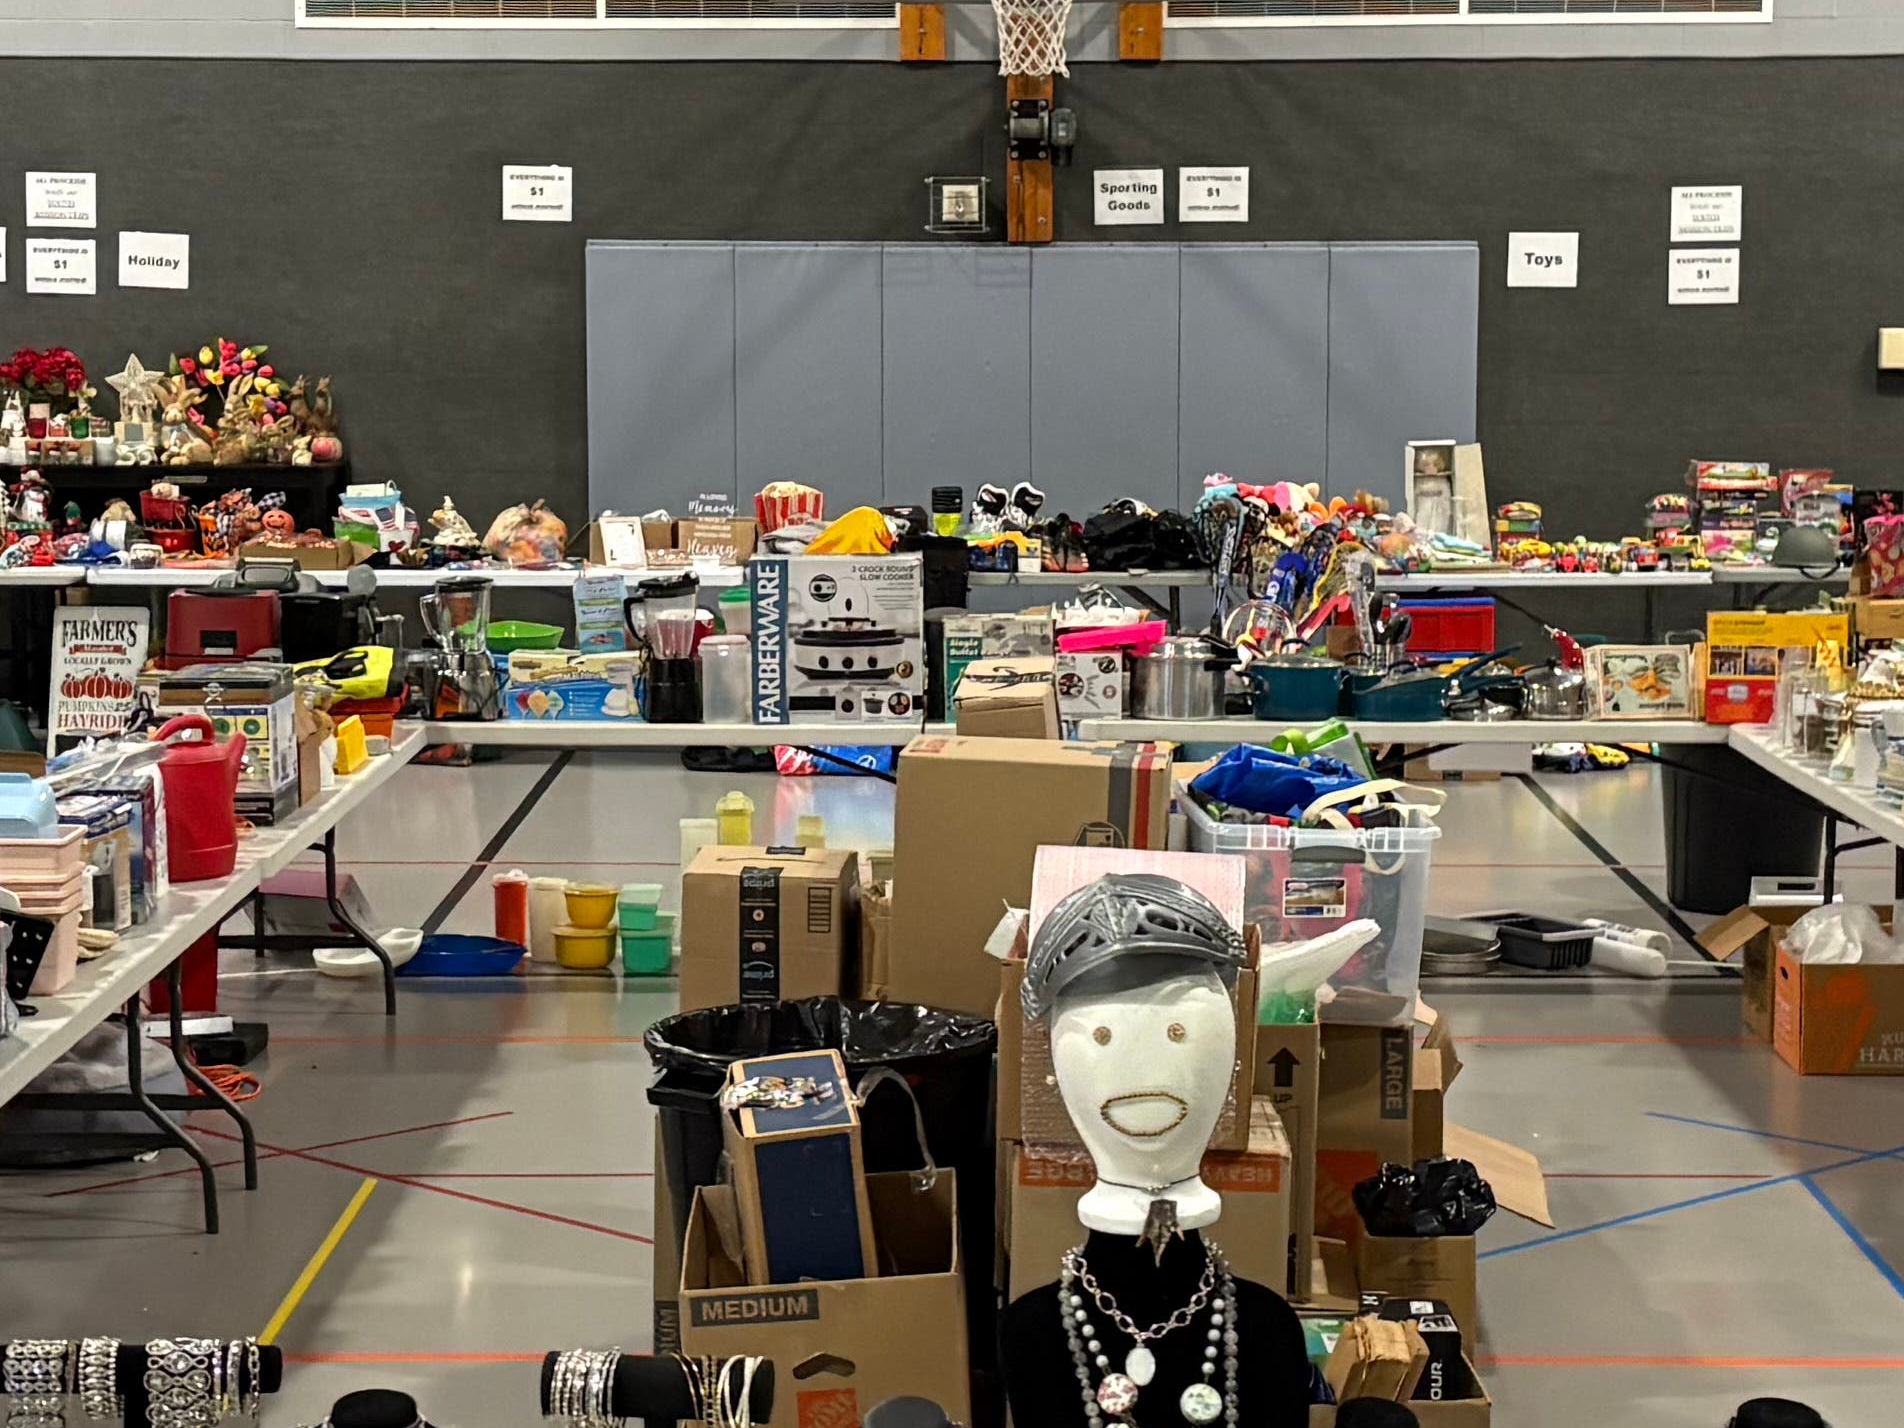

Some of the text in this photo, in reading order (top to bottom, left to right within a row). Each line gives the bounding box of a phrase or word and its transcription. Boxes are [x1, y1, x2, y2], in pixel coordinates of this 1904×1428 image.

[530, 186, 544, 196] $1
[1100, 182, 1158, 195] Sporting
[1207, 187, 1220, 197] $1
[1108, 199, 1150, 211] Goods
[53, 259, 67, 269] $1
[128, 254, 180, 270] Holiday
[1524, 252, 1563, 267] Toys
[62, 619, 138, 648] FARMER'S
[758, 563, 782, 723] FARBERWARE
[58, 701, 114, 712] PUMPKINS
[1385, 1037, 1404, 1111] LARGE
[701, 1294, 809, 1321] MEDIUM
